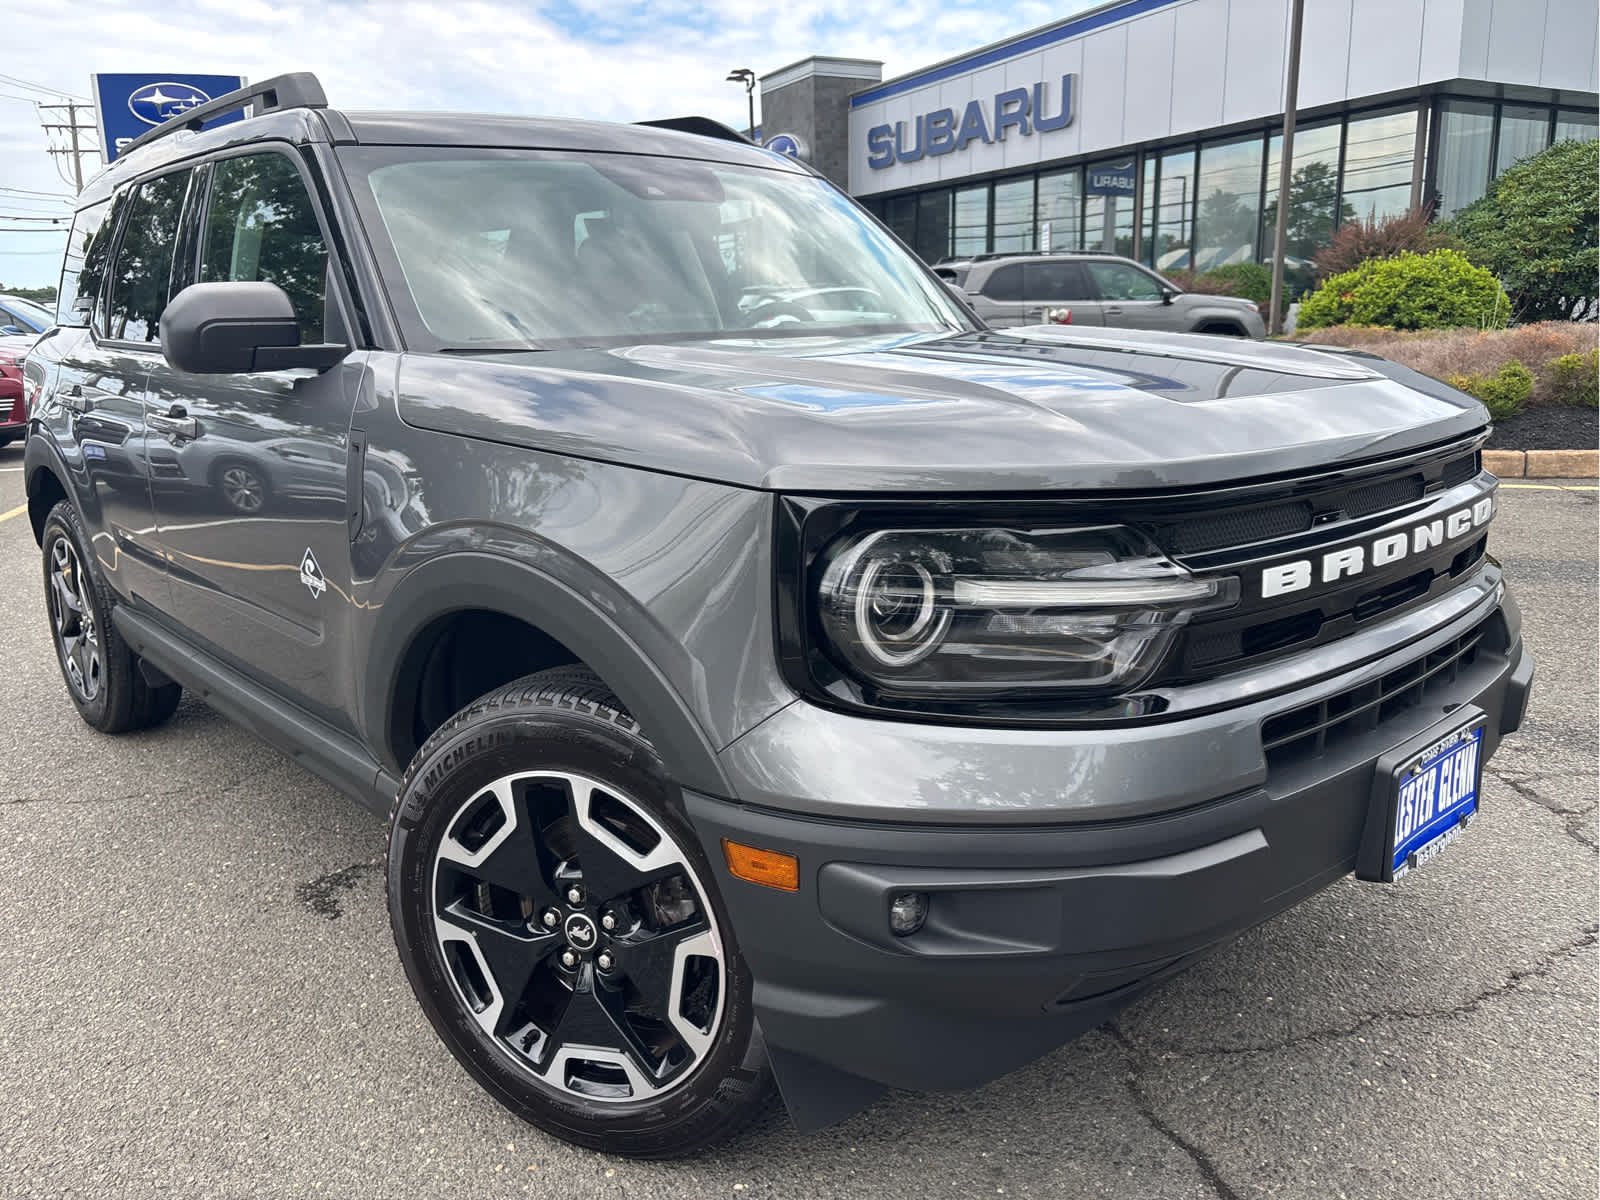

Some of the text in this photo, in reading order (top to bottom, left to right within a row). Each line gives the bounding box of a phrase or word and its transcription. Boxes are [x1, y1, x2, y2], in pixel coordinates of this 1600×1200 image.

[868, 73, 1077, 169] SUBARU
[1262, 498, 1493, 598] BRONCO
[424, 731, 510, 786] MICHELIN
[1395, 741, 1478, 847] LESTER GLENN
